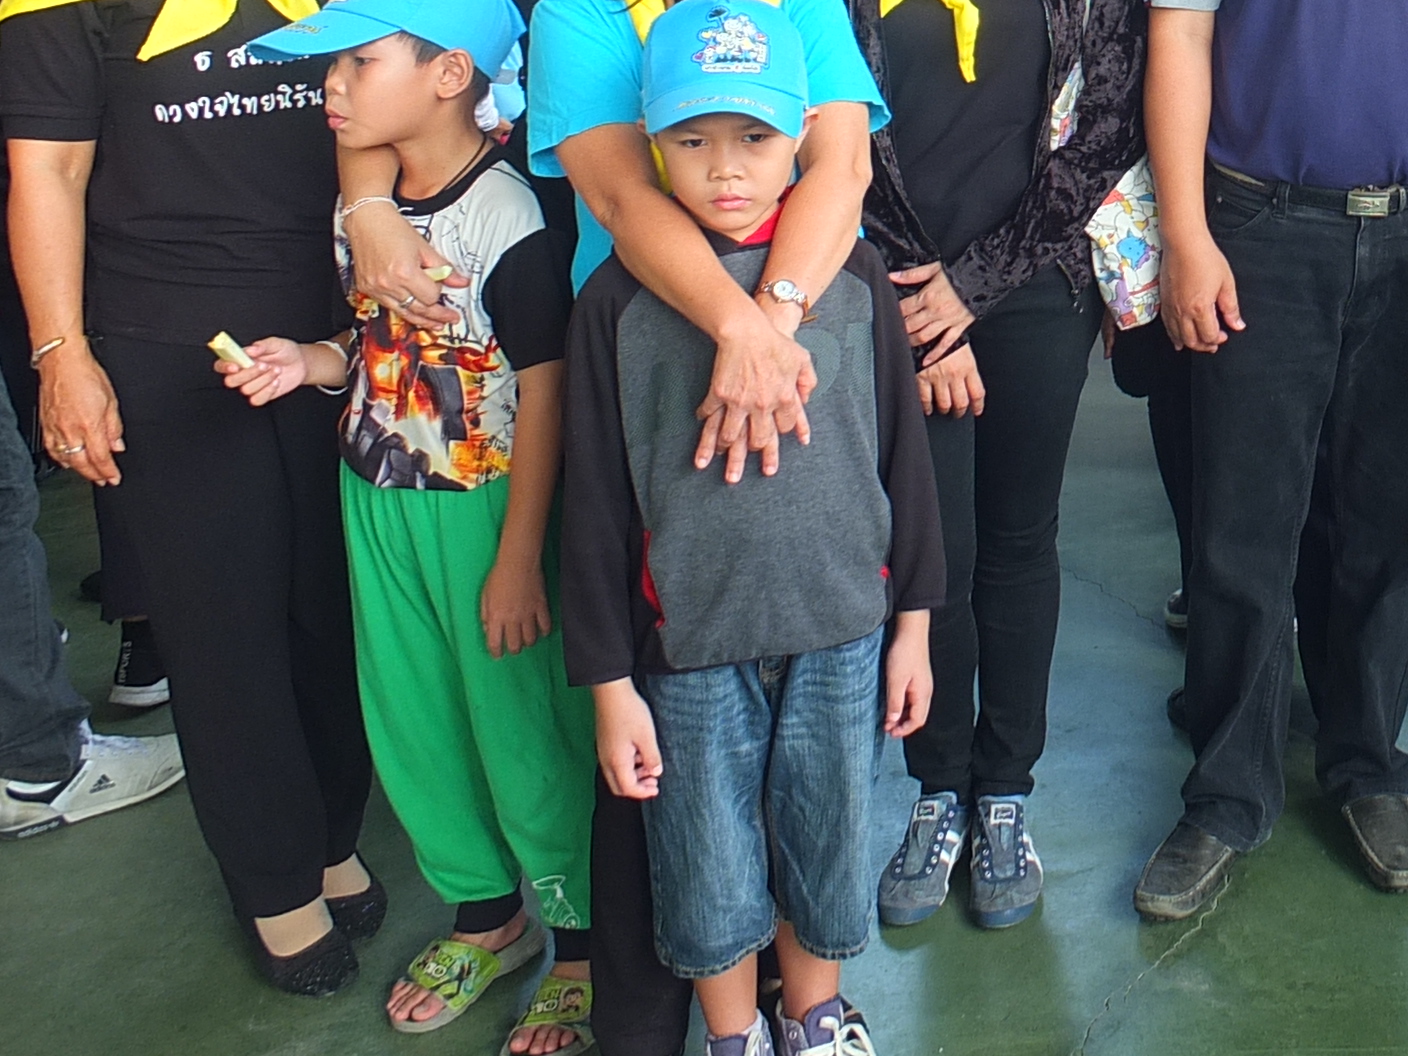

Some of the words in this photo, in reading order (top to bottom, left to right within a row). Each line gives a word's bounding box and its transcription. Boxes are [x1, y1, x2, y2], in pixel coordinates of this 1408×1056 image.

[154, 83, 324, 124] ดวงใจไทยนิรัน
